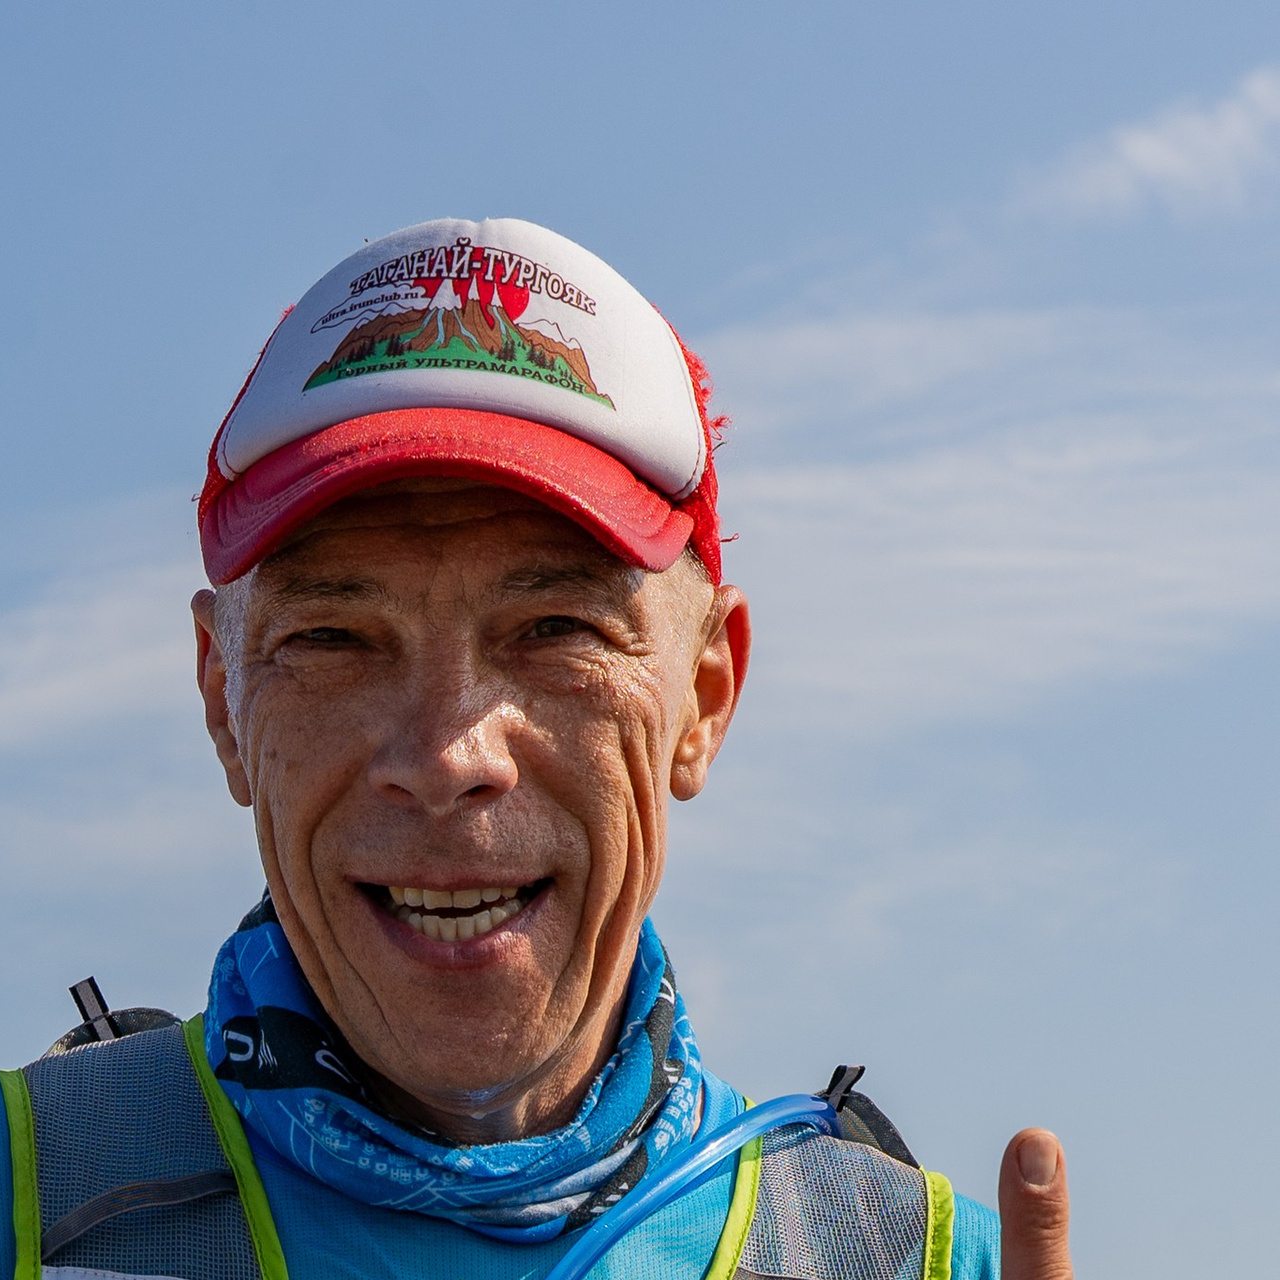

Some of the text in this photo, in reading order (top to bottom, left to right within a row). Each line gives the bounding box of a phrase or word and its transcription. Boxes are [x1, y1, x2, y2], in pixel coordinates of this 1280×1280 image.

[350, 237, 596, 316] ТАГАНАЙ-ТУРГОЯК
[321, 289, 419, 326] ultra.irunclub.ru
[414, 358, 586, 395] УЛЬТРАМАРАФОН
